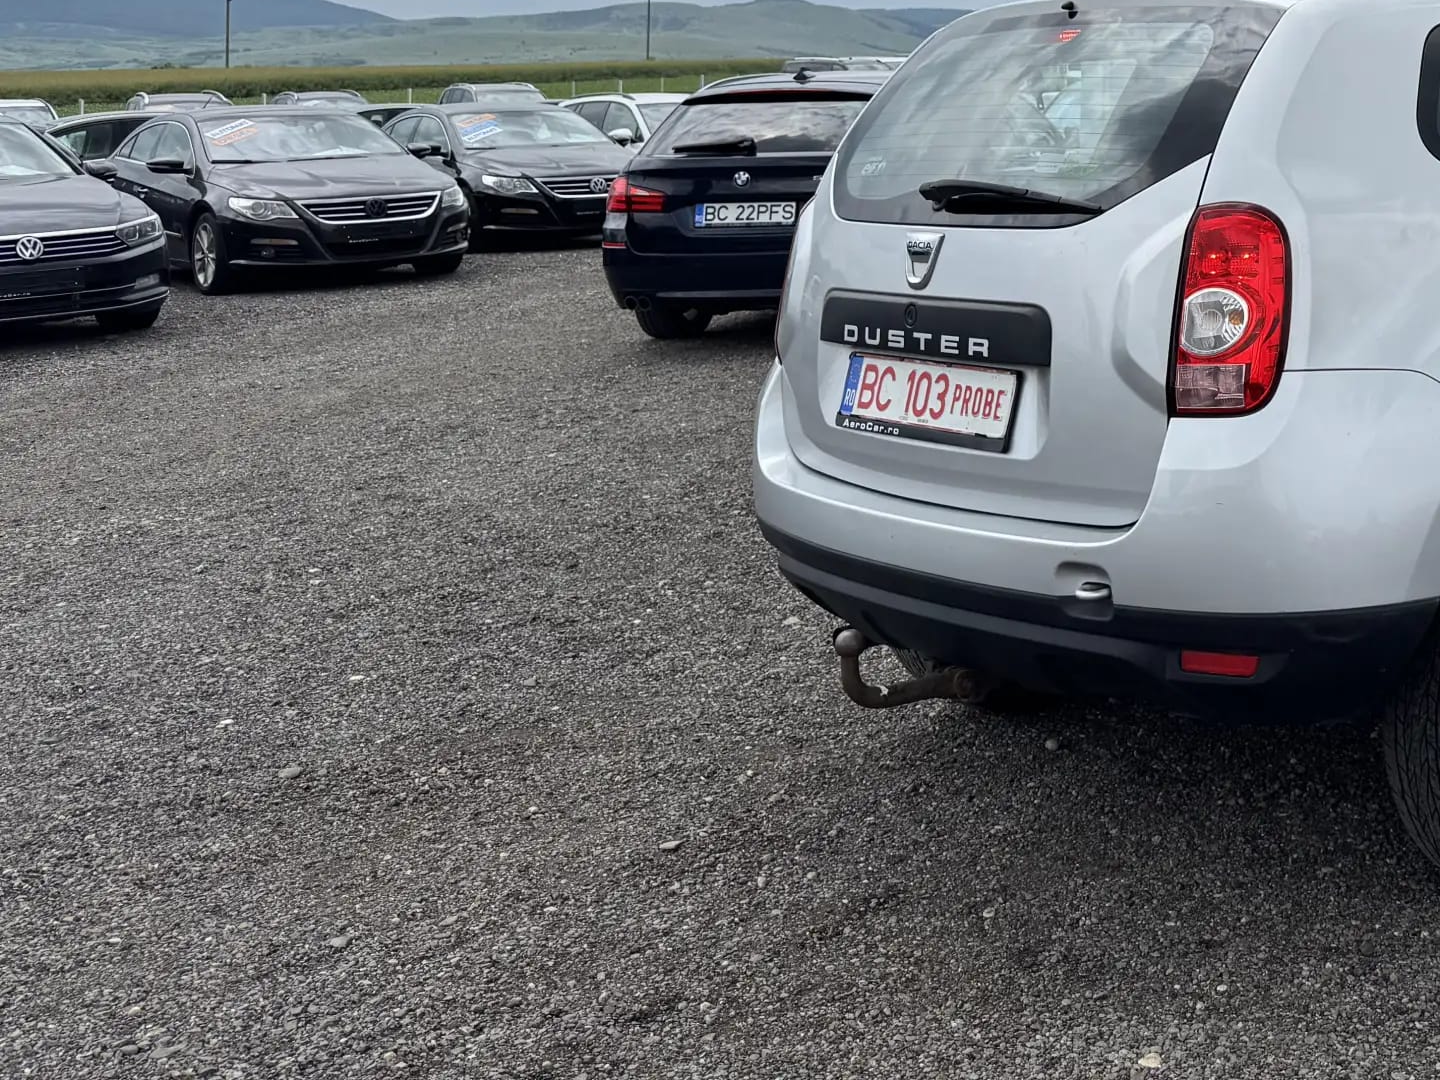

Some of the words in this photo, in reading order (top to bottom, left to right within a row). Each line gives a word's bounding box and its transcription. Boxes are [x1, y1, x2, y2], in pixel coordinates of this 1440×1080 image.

[704, 205, 729, 222] BC
[735, 204, 794, 221] 22PFS
[907, 240, 933, 250] DACIA
[843, 324, 989, 358] DUSTER
[844, 388, 856, 408] RO
[857, 363, 896, 412] BC
[904, 368, 950, 421] 103
[950, 383, 1007, 422] PROBE
[842, 418, 900, 436] AeroCar.ro
